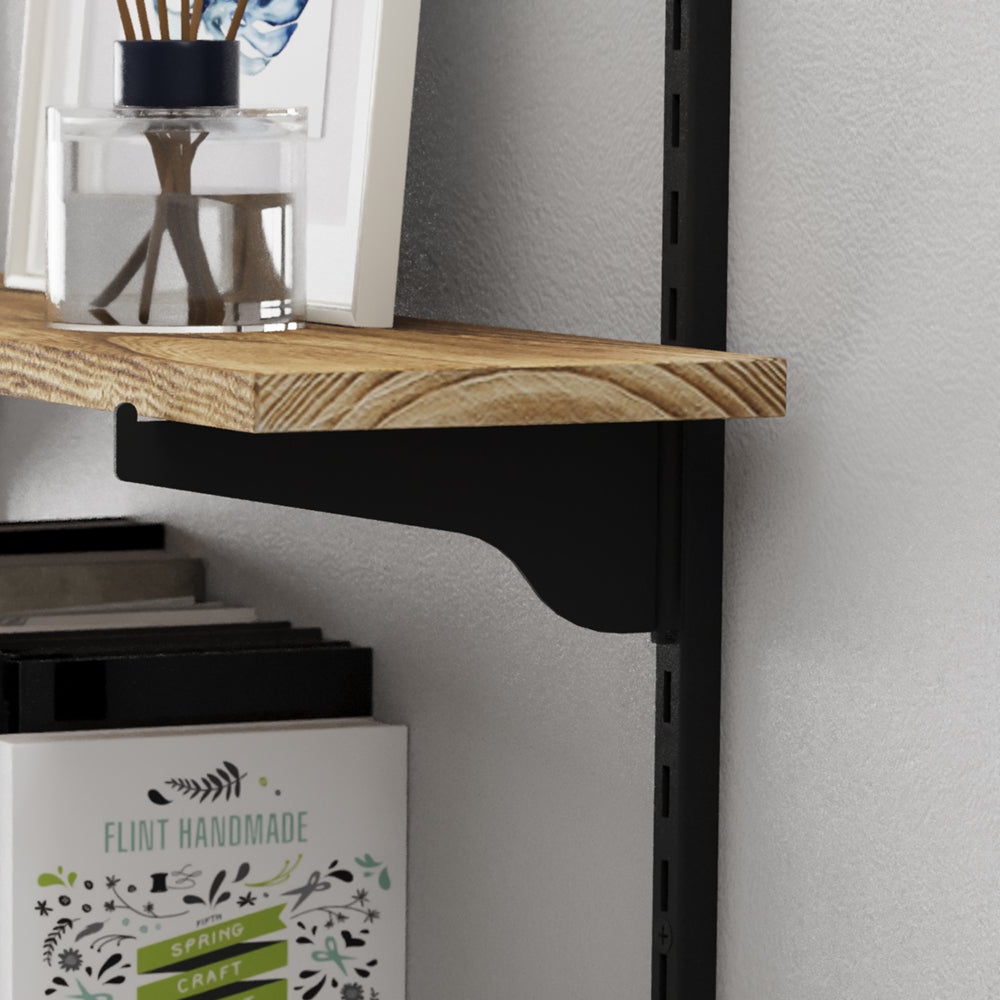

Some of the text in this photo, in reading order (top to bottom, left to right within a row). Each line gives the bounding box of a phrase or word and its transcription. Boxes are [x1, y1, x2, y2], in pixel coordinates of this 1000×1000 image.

[104, 811, 308, 854] FLINT HANDMADE
[170, 922, 245, 958] SPRING
[177, 960, 242, 994] CRAFT
